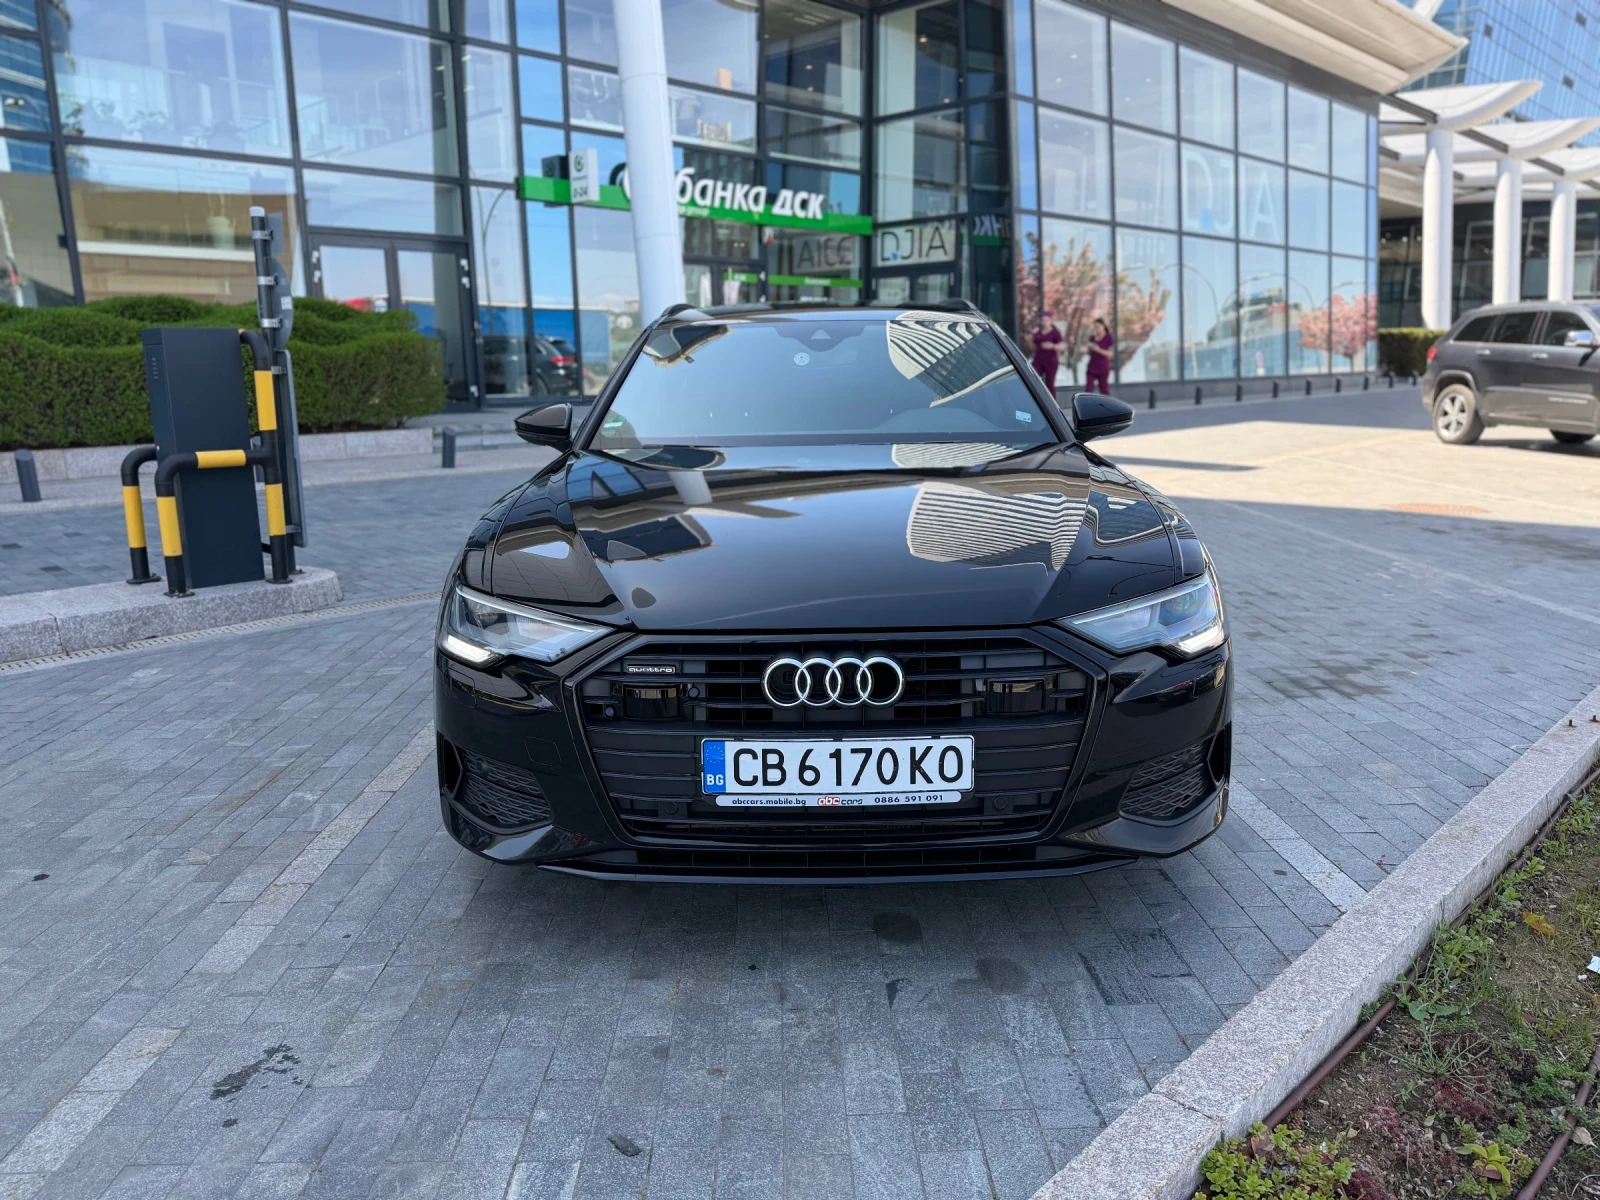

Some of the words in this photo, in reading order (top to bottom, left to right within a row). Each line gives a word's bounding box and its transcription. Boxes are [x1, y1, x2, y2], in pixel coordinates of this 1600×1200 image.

[675, 167, 767, 213] банка
[880, 225, 948, 262] DJIA
[706, 774, 724, 785] BG
[733, 748, 787, 786] CB
[798, 747, 899, 786] 6170
[732, 798, 807, 806] abccars.mobile.bg
[904, 795, 921, 803] 591
[926, 794, 943, 802] 091
